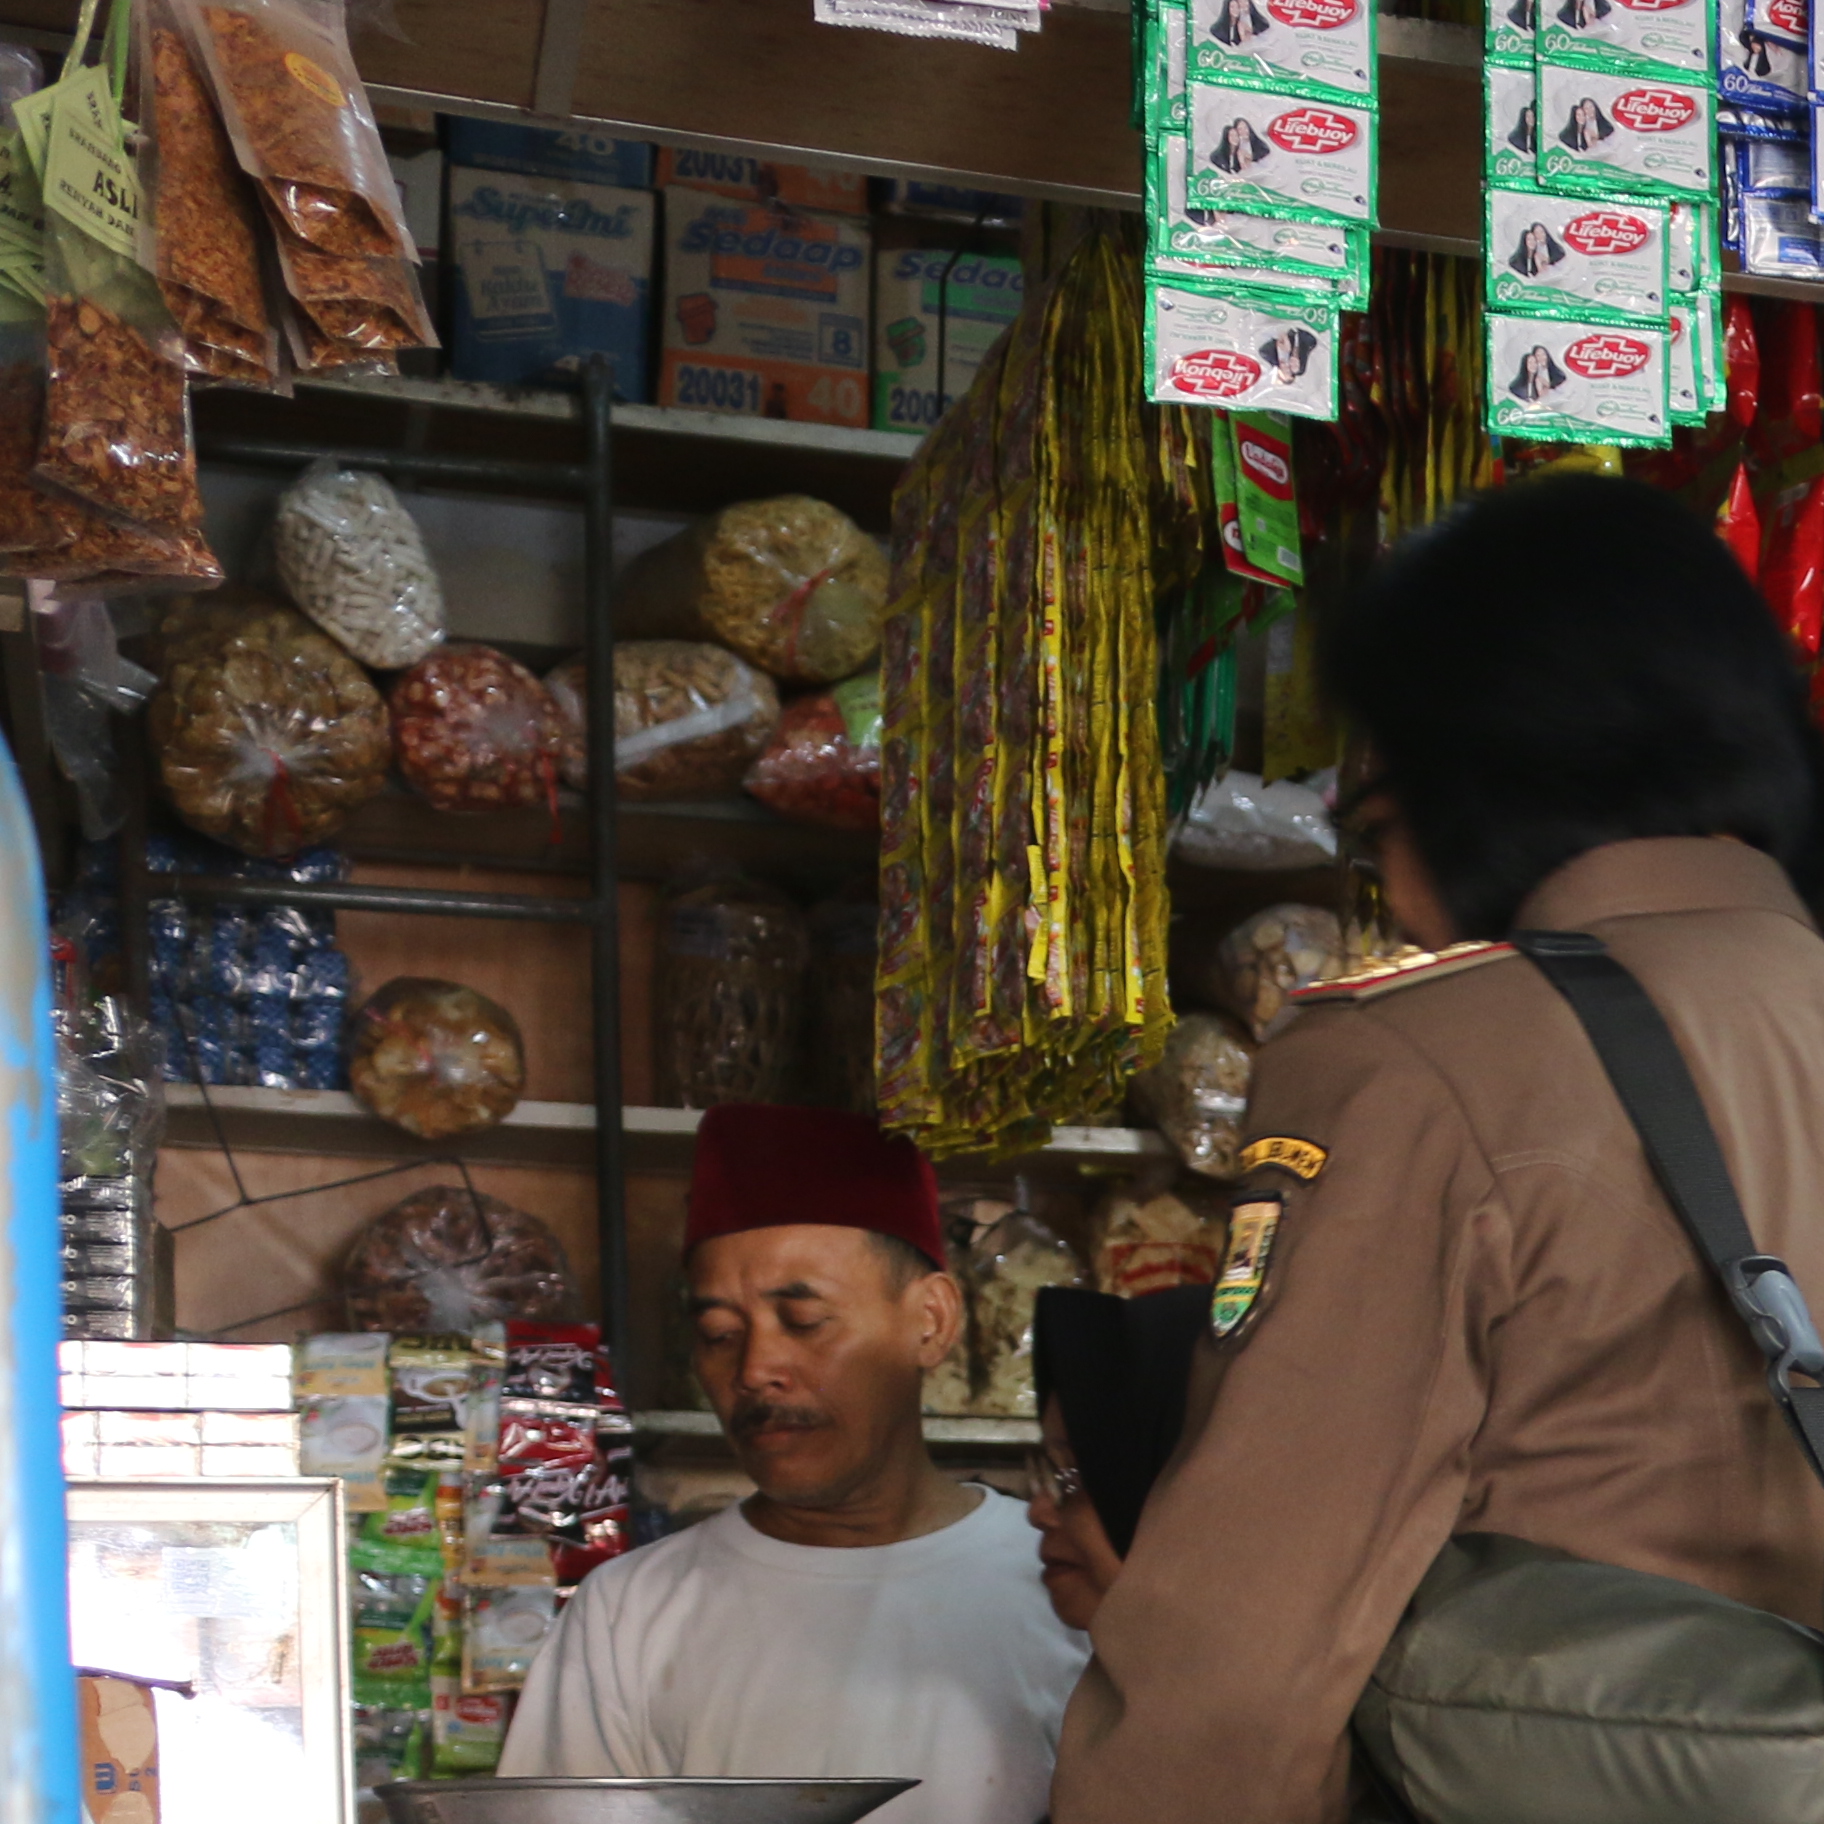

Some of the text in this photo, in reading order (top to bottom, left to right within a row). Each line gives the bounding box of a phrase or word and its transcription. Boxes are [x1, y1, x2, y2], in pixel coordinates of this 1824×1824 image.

[1724, 73, 1748, 91] 60
[1617, 98, 1692, 119] Lifebuoy
[1273, 119, 1353, 144] Lifebuoy
[93, 169, 138, 219] ASLI
[1569, 224, 1644, 245] Lifebuoy
[680, 220, 863, 275] Sedaap
[1570, 346, 1646, 366] Lifebuoy
[676, 366, 761, 412] 20031
[807, 378, 860, 420] 40
